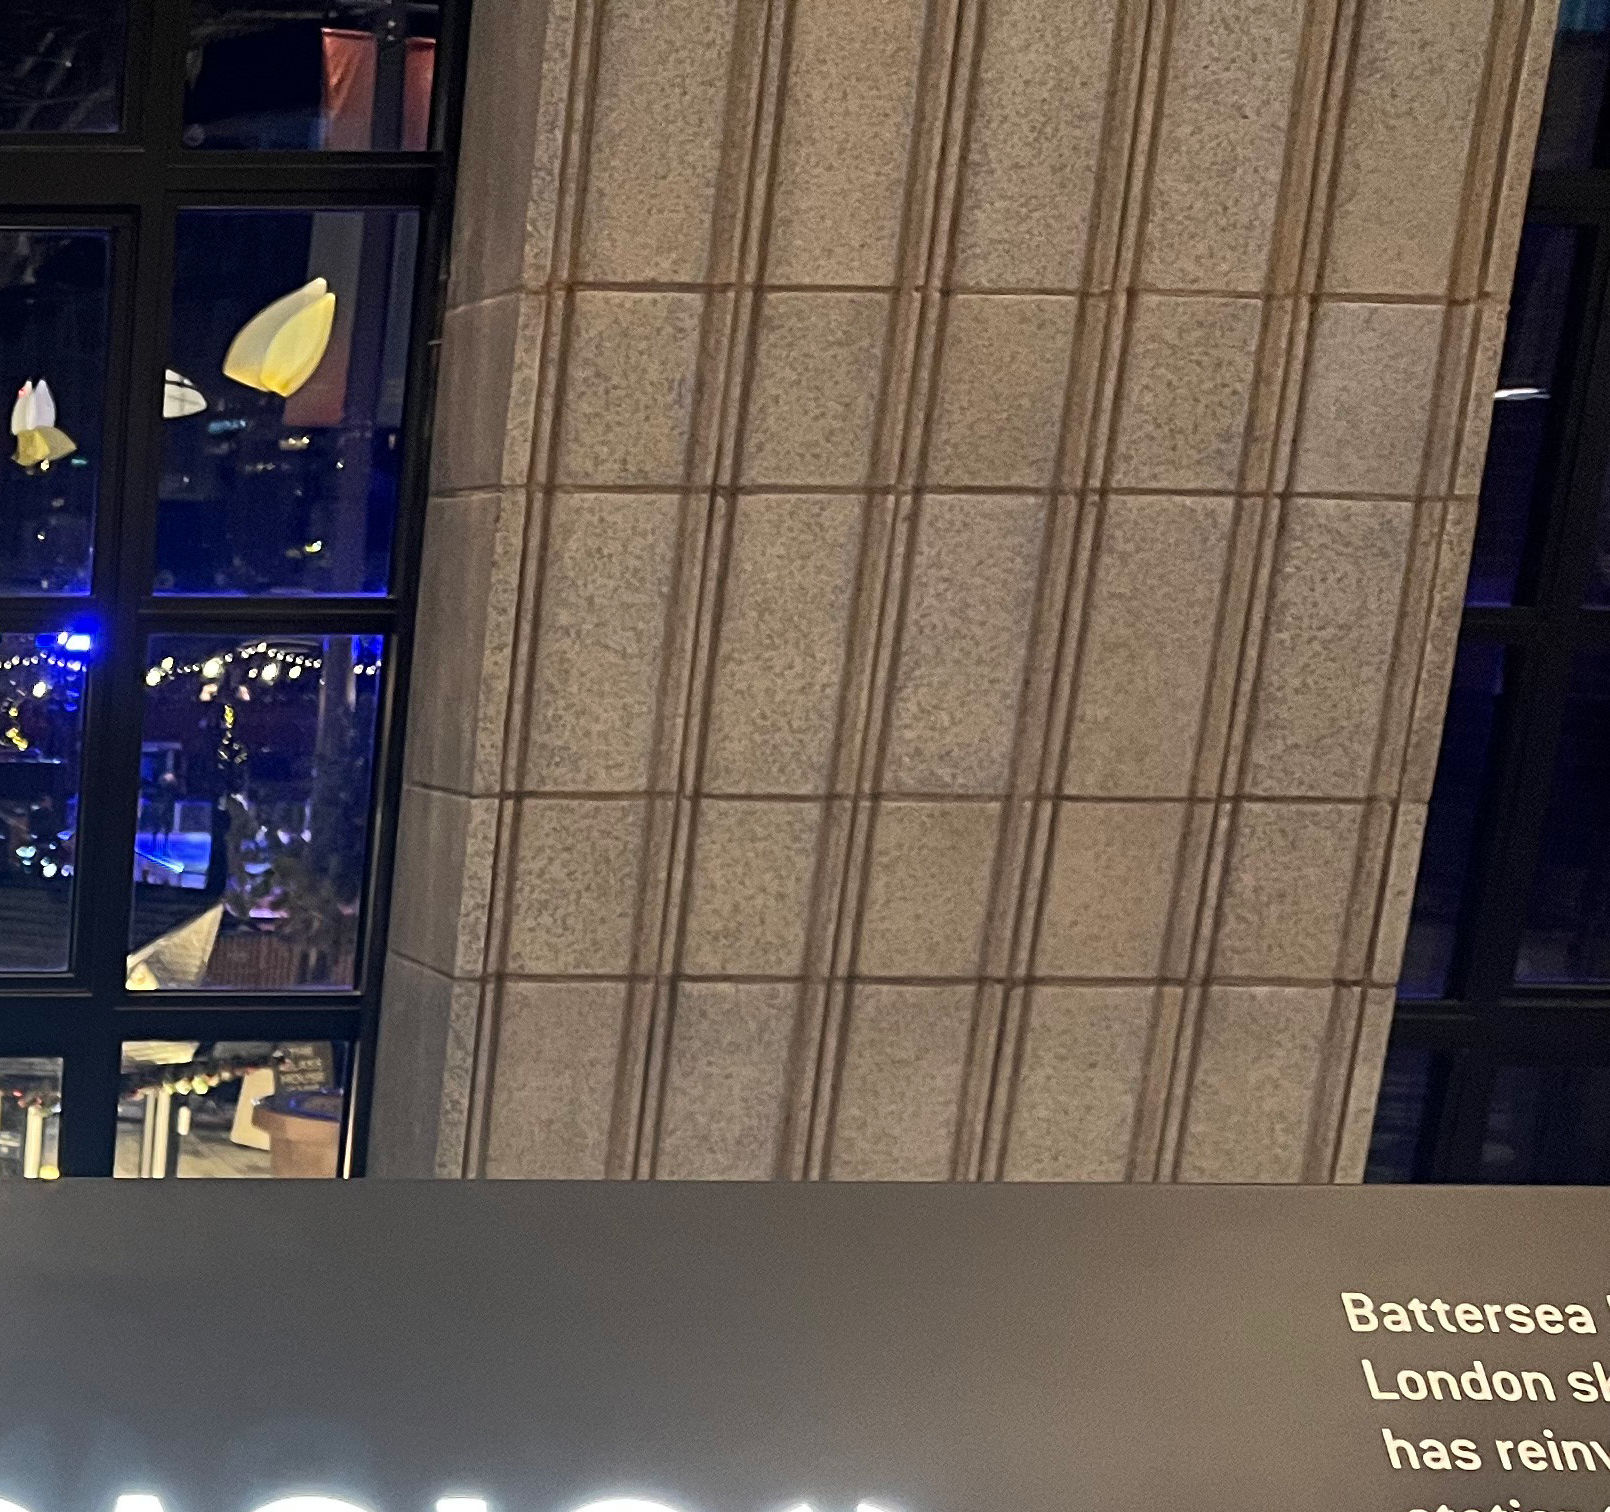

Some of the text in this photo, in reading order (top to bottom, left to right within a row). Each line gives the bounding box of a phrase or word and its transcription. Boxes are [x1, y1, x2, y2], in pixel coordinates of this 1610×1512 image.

[1340, 1291, 1597, 1334] Battersea
[1361, 1358, 1557, 1402] London
[1381, 1428, 1482, 1471] has
